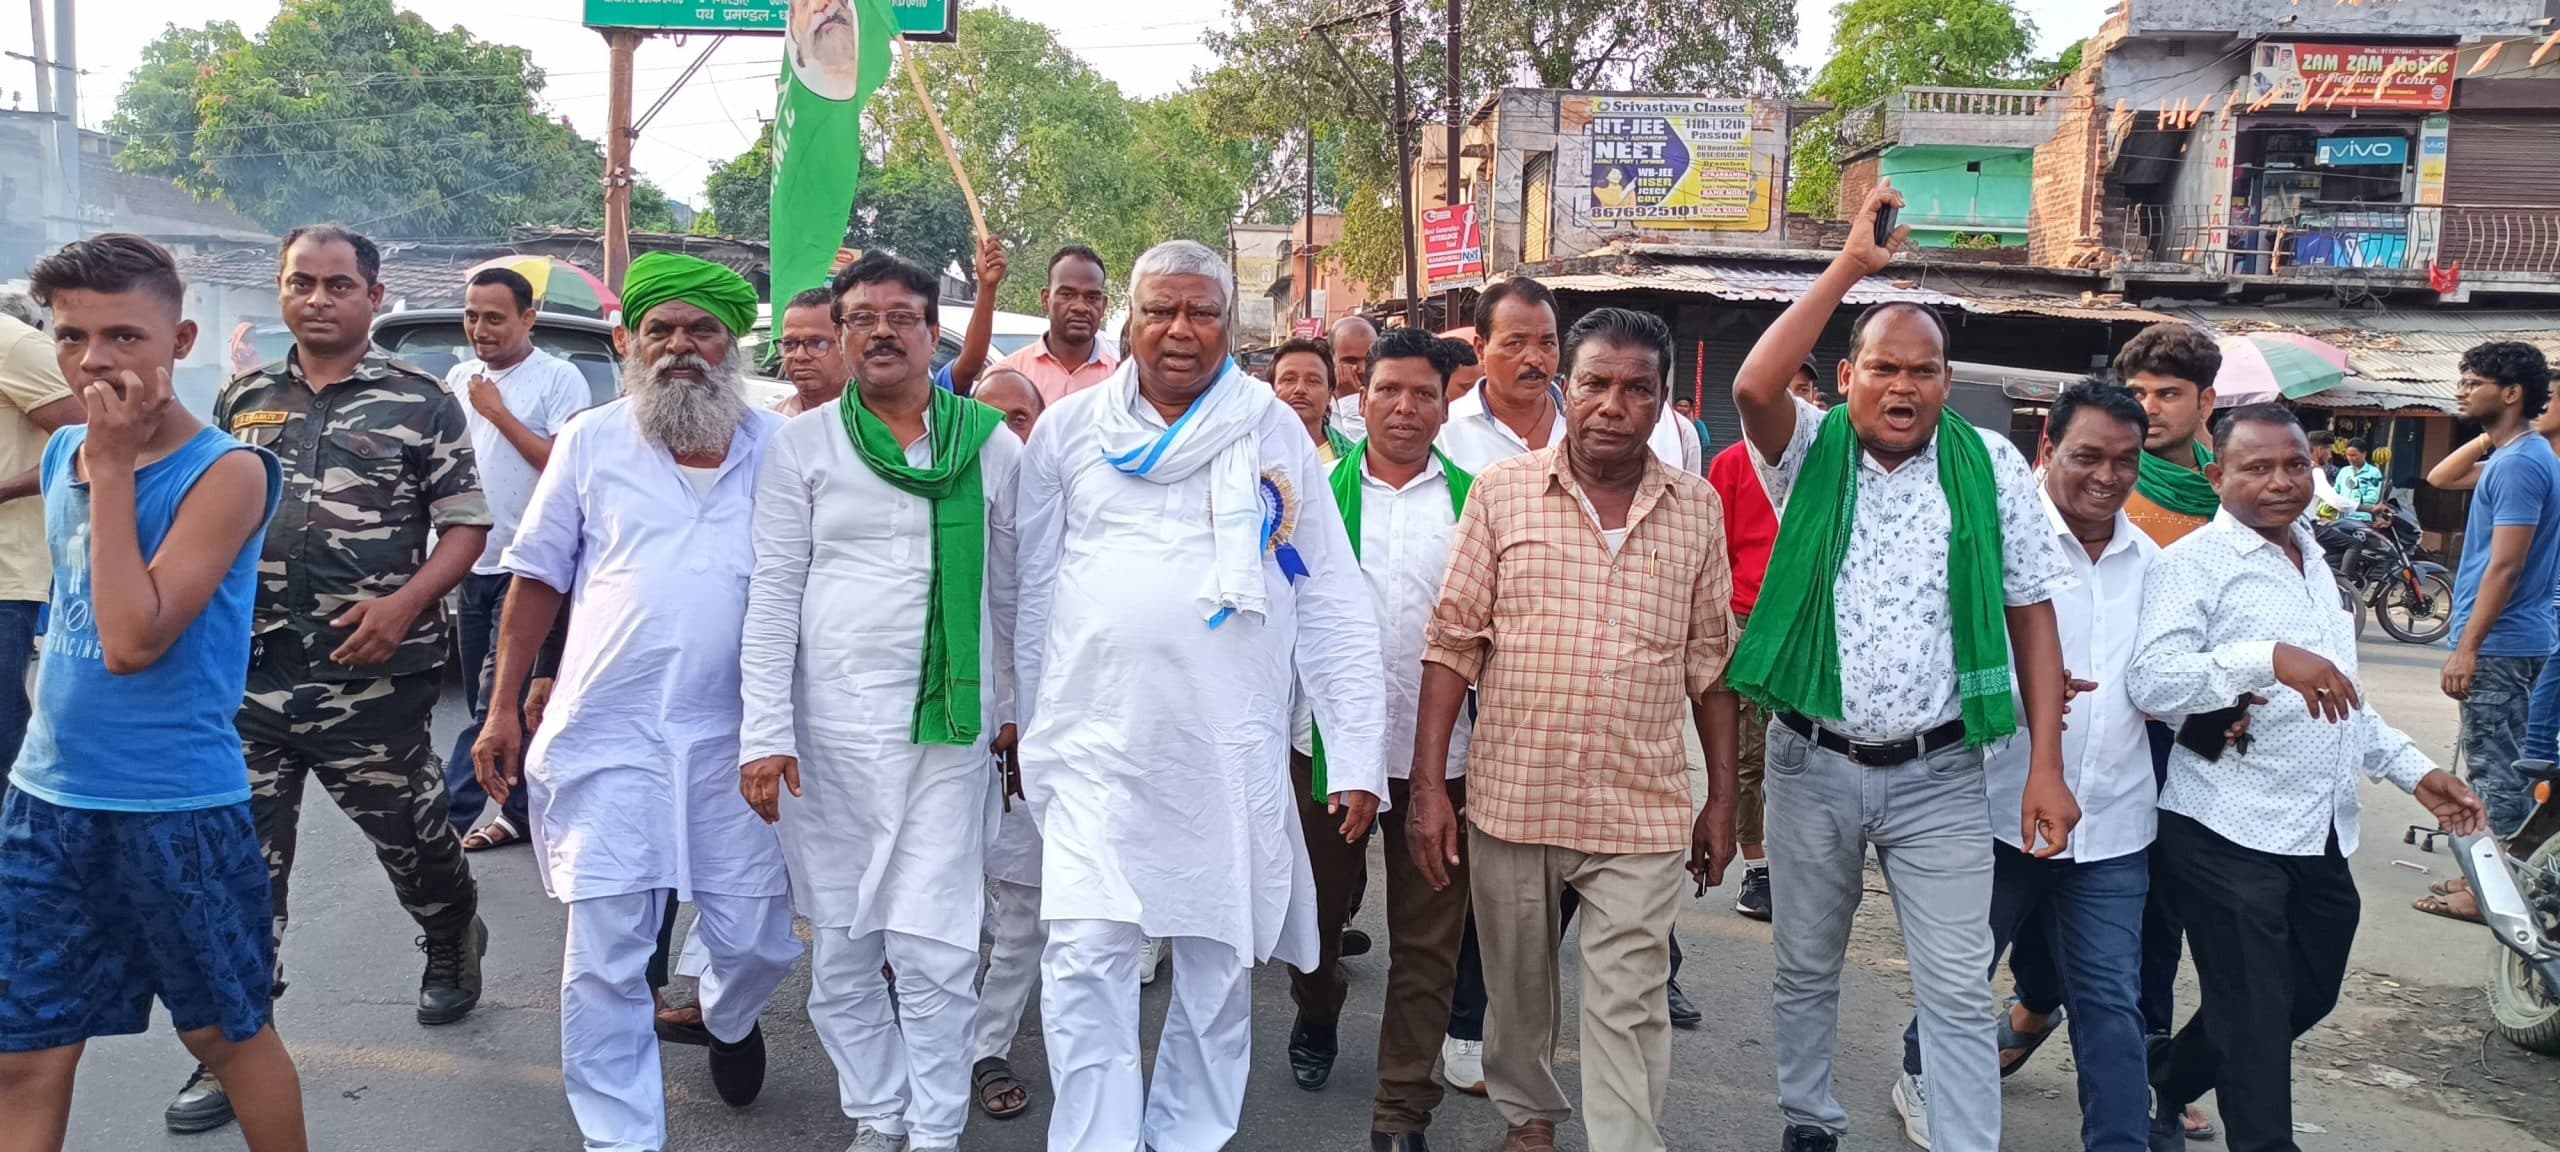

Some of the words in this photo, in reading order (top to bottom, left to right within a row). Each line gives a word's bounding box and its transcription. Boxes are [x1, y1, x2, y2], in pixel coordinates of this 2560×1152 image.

[2303, 54, 2339, 71] ZAM
[2346, 55, 2382, 72] ZAM
[2393, 56, 2448, 74] Mobile
[2396, 74, 2437, 86] Centre
[1613, 101, 1690, 113] Srivastava
[1694, 102, 1745, 113] Classes
[1594, 119, 1665, 135] IIT-JEE
[1686, 118, 1709, 129] 11th
[1720, 118, 1745, 129] 12th
[1691, 131, 1742, 140] Passout
[2216, 119, 2229, 168] ZAM
[2331, 140, 2392, 157] vivo
[1595, 142, 1667, 159] NEET
[1638, 168, 1673, 177] WB-JEE
[1638, 178, 1672, 187] IISER
[1637, 187, 1667, 195] JCECE
[1637, 195, 1663, 203] CUET
[1591, 205, 1699, 217] 8676925101
